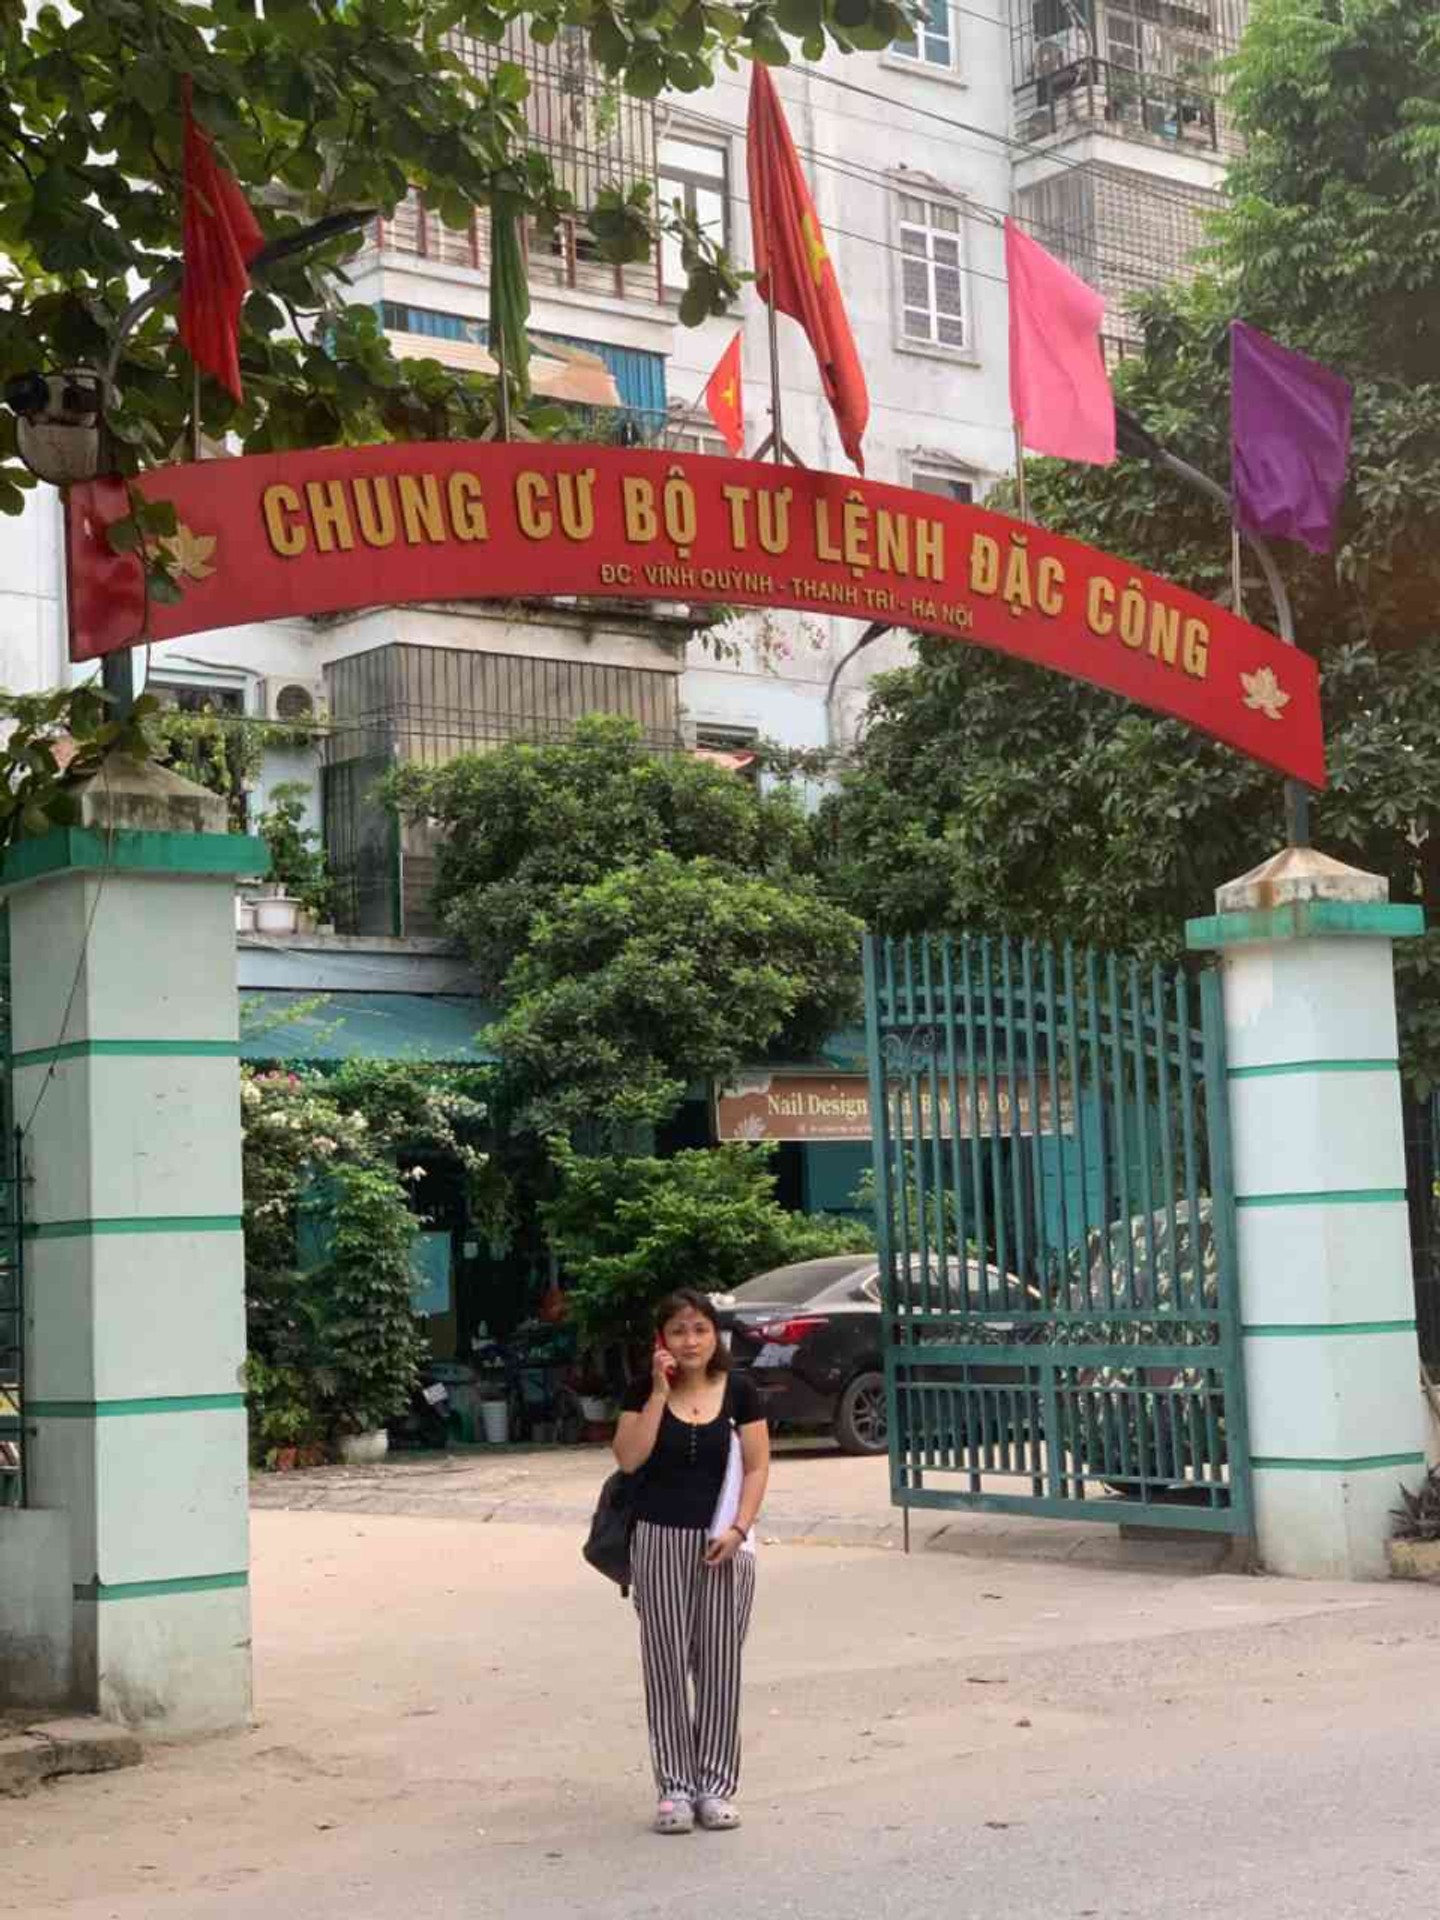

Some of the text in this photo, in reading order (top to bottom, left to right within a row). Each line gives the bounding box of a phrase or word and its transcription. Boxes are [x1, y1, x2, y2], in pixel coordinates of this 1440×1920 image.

[264, 467, 1211, 678] CHUNG CƯ BỘ TƯ LỆNH ĐẶC CÔNG
[792, 578, 857, 605] THANH
[768, 1093, 803, 1116] Nail
[808, 1093, 867, 1120] Design
